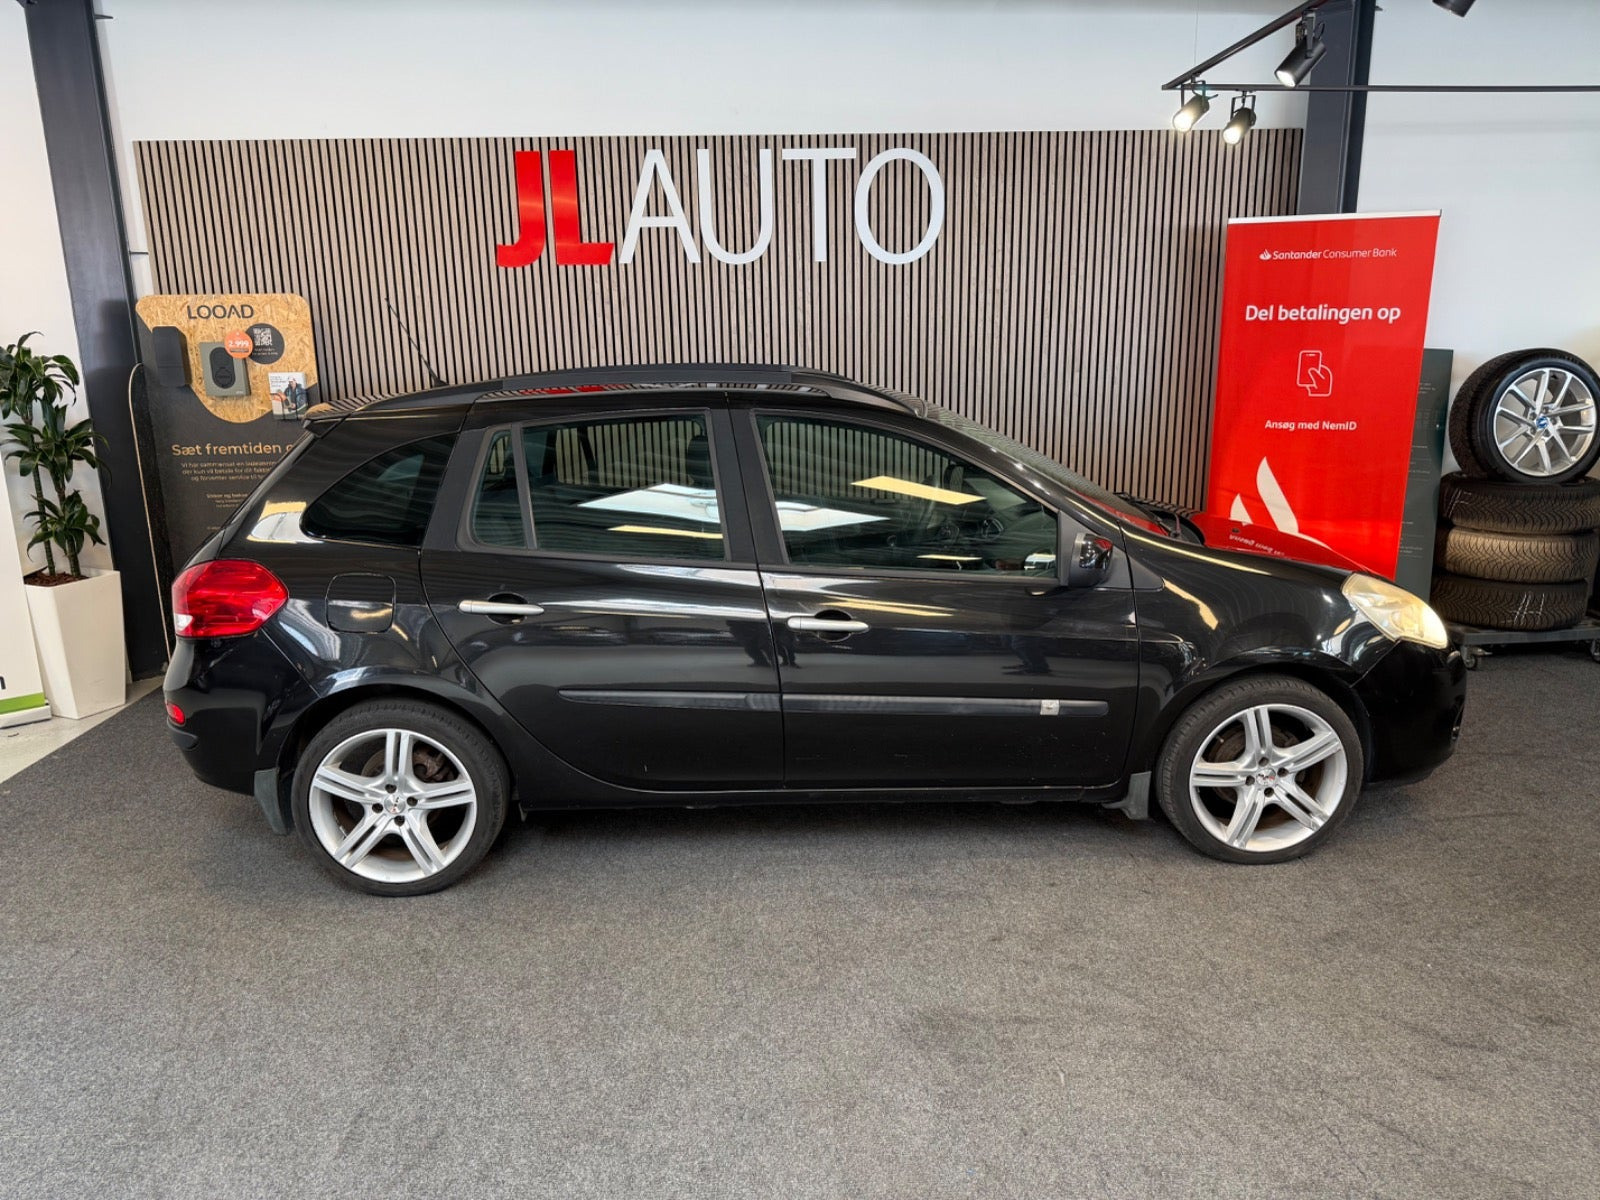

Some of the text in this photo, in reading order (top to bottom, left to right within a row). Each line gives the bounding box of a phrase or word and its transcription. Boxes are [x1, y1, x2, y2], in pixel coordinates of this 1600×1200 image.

[619, 147, 945, 265] AUTO
[1273, 248, 1397, 261] Santander Consumer Bank
[187, 304, 255, 320] LOOAD
[1245, 304, 1401, 325] Del betalingen op
[1265, 420, 1357, 432] Ansøg med NemID
[171, 444, 202, 456] Sæt
[205, 442, 282, 456] fremtiden
